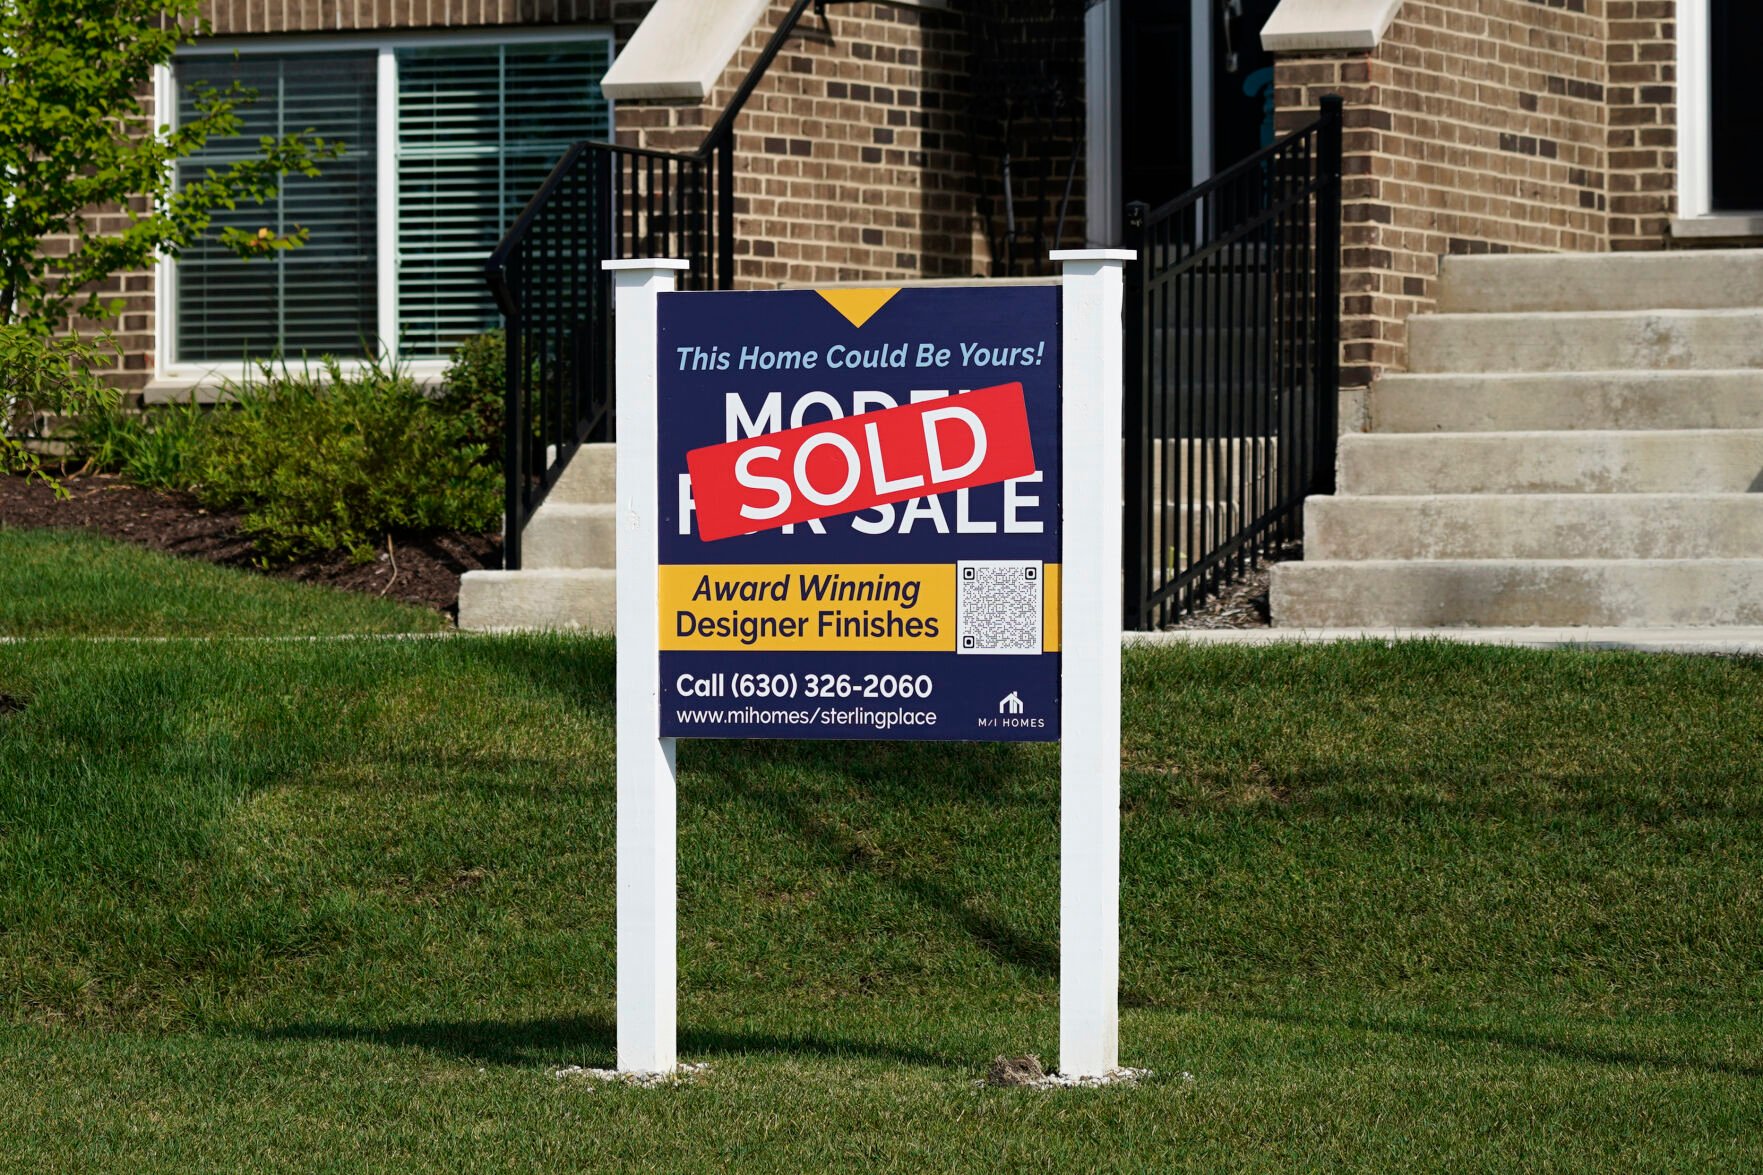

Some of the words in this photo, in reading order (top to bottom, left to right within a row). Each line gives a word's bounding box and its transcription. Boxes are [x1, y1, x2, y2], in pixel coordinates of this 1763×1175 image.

[676, 346, 731, 371] This
[738, 345, 818, 370] Home
[826, 343, 908, 369] Could
[915, 343, 951, 368] Be
[959, 341, 1045, 367] Yours!
[734, 406, 988, 520] SOLD
[692, 574, 791, 602] Award
[799, 574, 921, 609] Winning
[676, 610, 809, 645] Designer
[818, 610, 939, 638] Finishes
[676, 673, 724, 697] Call
[731, 673, 798, 699] (630)
[804, 674, 933, 698] 326-2060
[676, 706, 937, 730] www.mihomes/sterlingplace
[978, 718, 997, 727] M/I
[1002, 718, 1045, 728] HOMES
